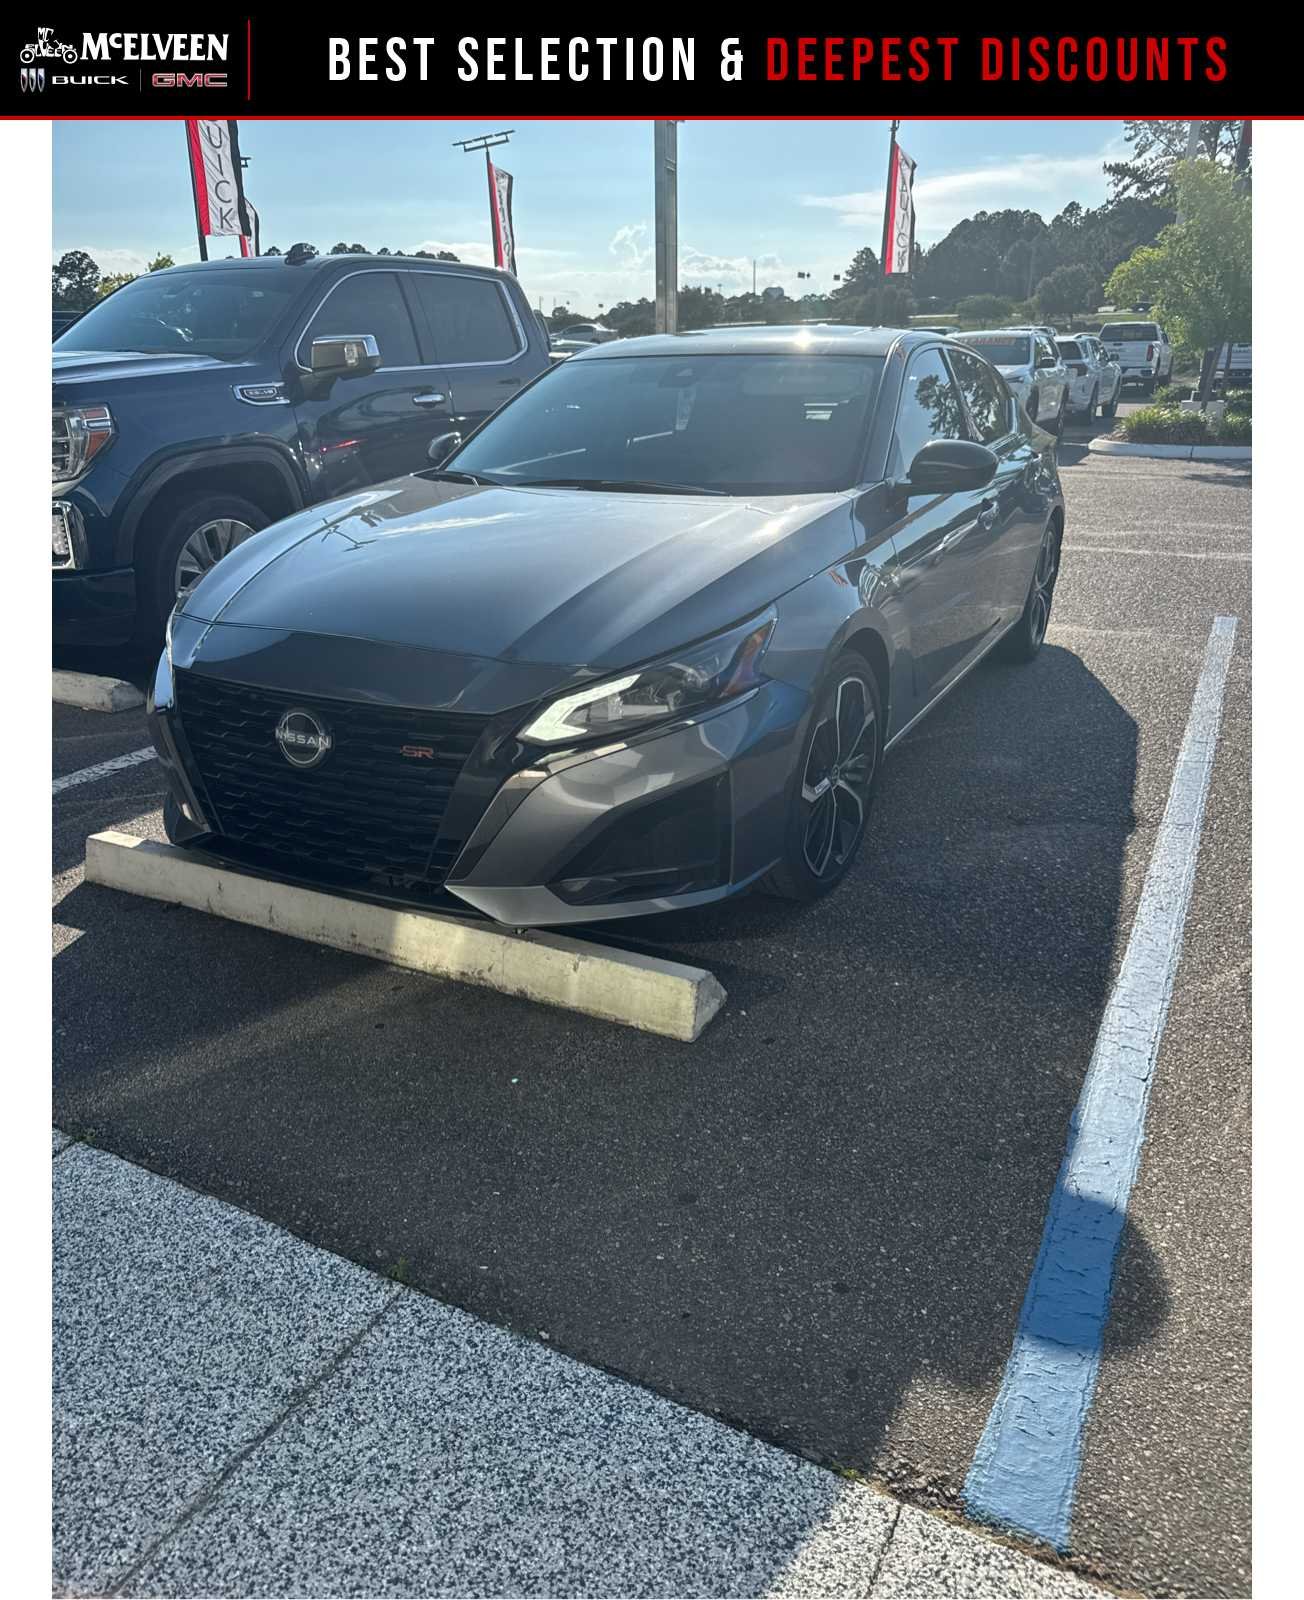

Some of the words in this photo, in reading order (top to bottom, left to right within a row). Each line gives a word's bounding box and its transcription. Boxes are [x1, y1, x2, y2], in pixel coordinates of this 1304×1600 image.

[206, 119, 234, 229] UICK
[275, 728, 330, 747] NISSAN
[400, 744, 434, 760] SR
